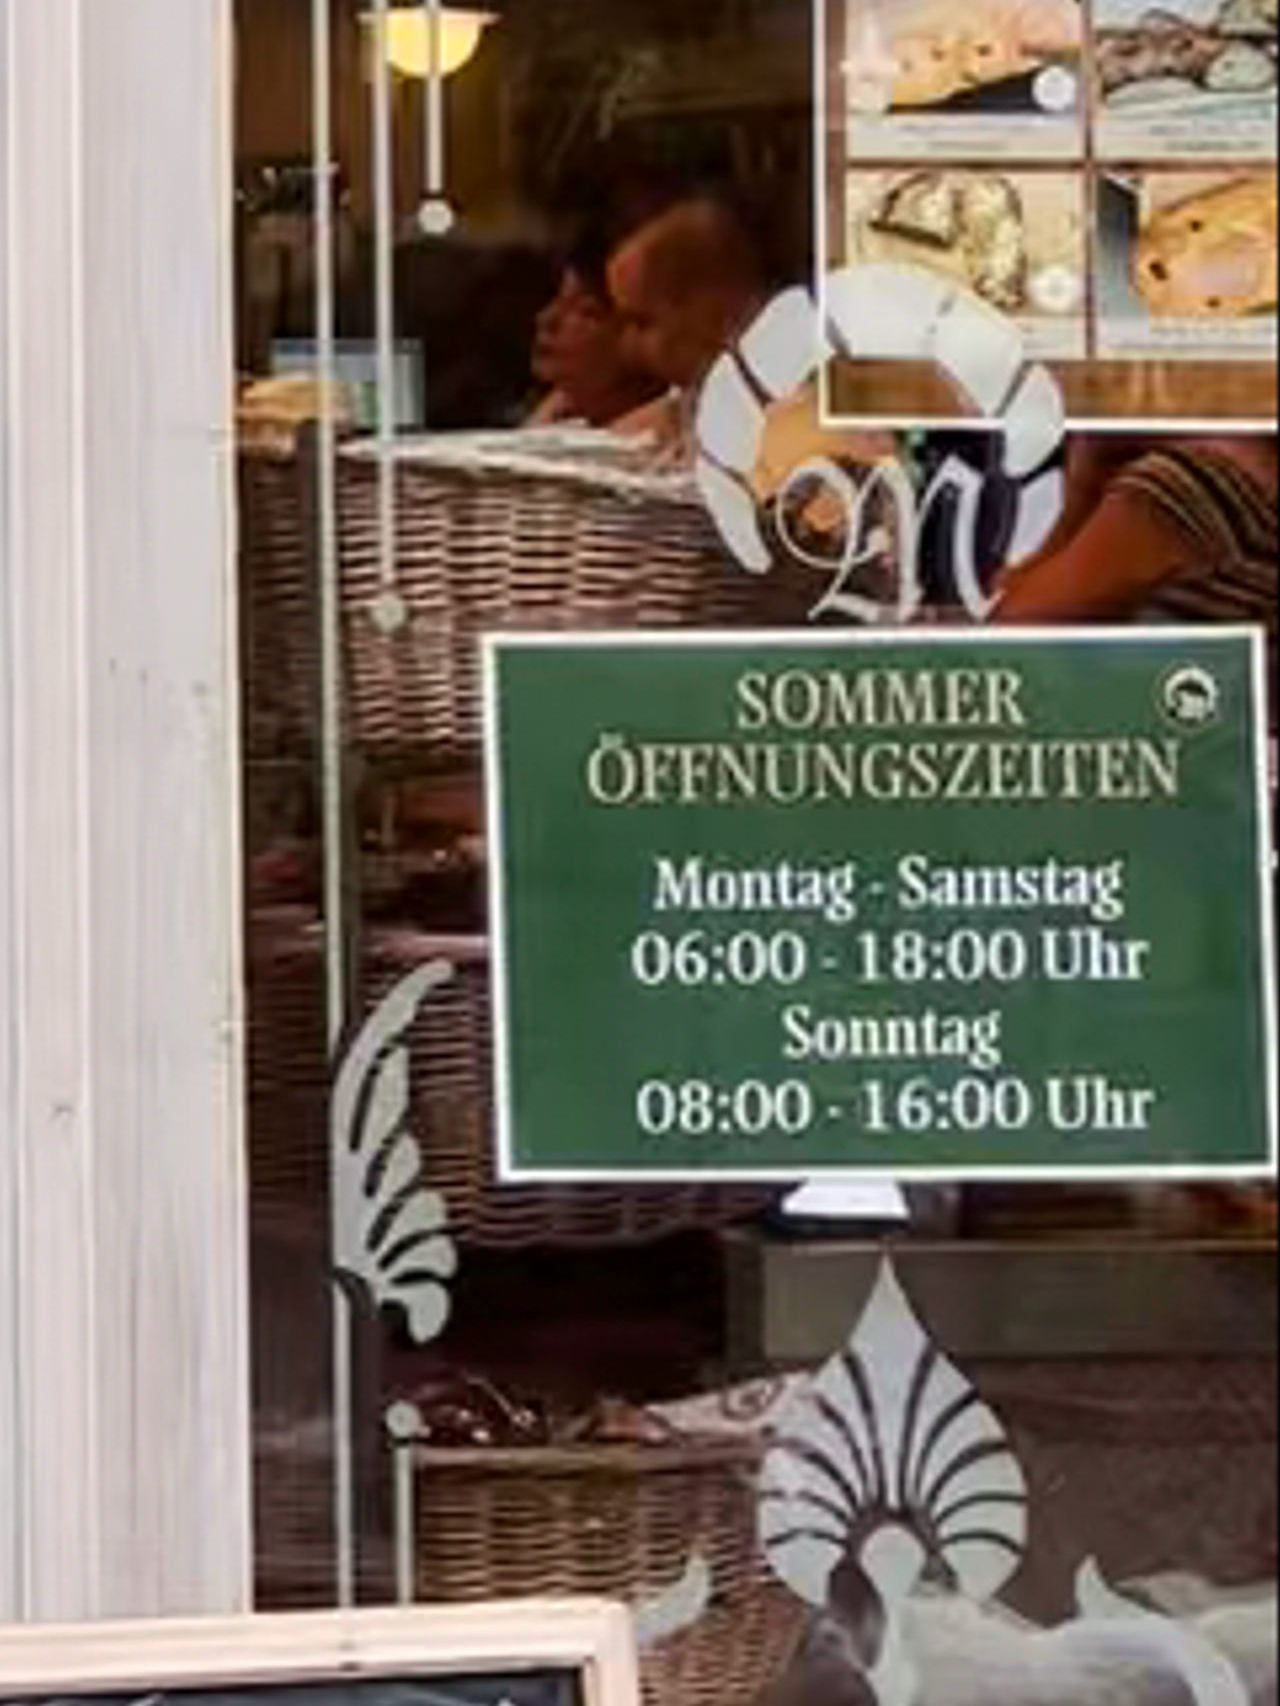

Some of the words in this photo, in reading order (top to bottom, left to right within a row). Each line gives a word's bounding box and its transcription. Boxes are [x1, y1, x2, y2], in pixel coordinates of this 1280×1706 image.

[737, 668, 1026, 730] SOMMER
[587, 733, 1181, 803] ÖFFNUNGSZEITEN
[653, 857, 856, 922] Montag
[897, 854, 1125, 920] Samstag
[631, 929, 806, 984] 06:00
[856, 928, 1028, 982] 18:00
[1041, 927, 1150, 981] Uhr
[781, 1003, 1004, 1069] Sonntag
[636, 1079, 812, 1135] 08:00
[864, 1078, 1032, 1131] 16:00
[1045, 1075, 1155, 1129] Uhr
